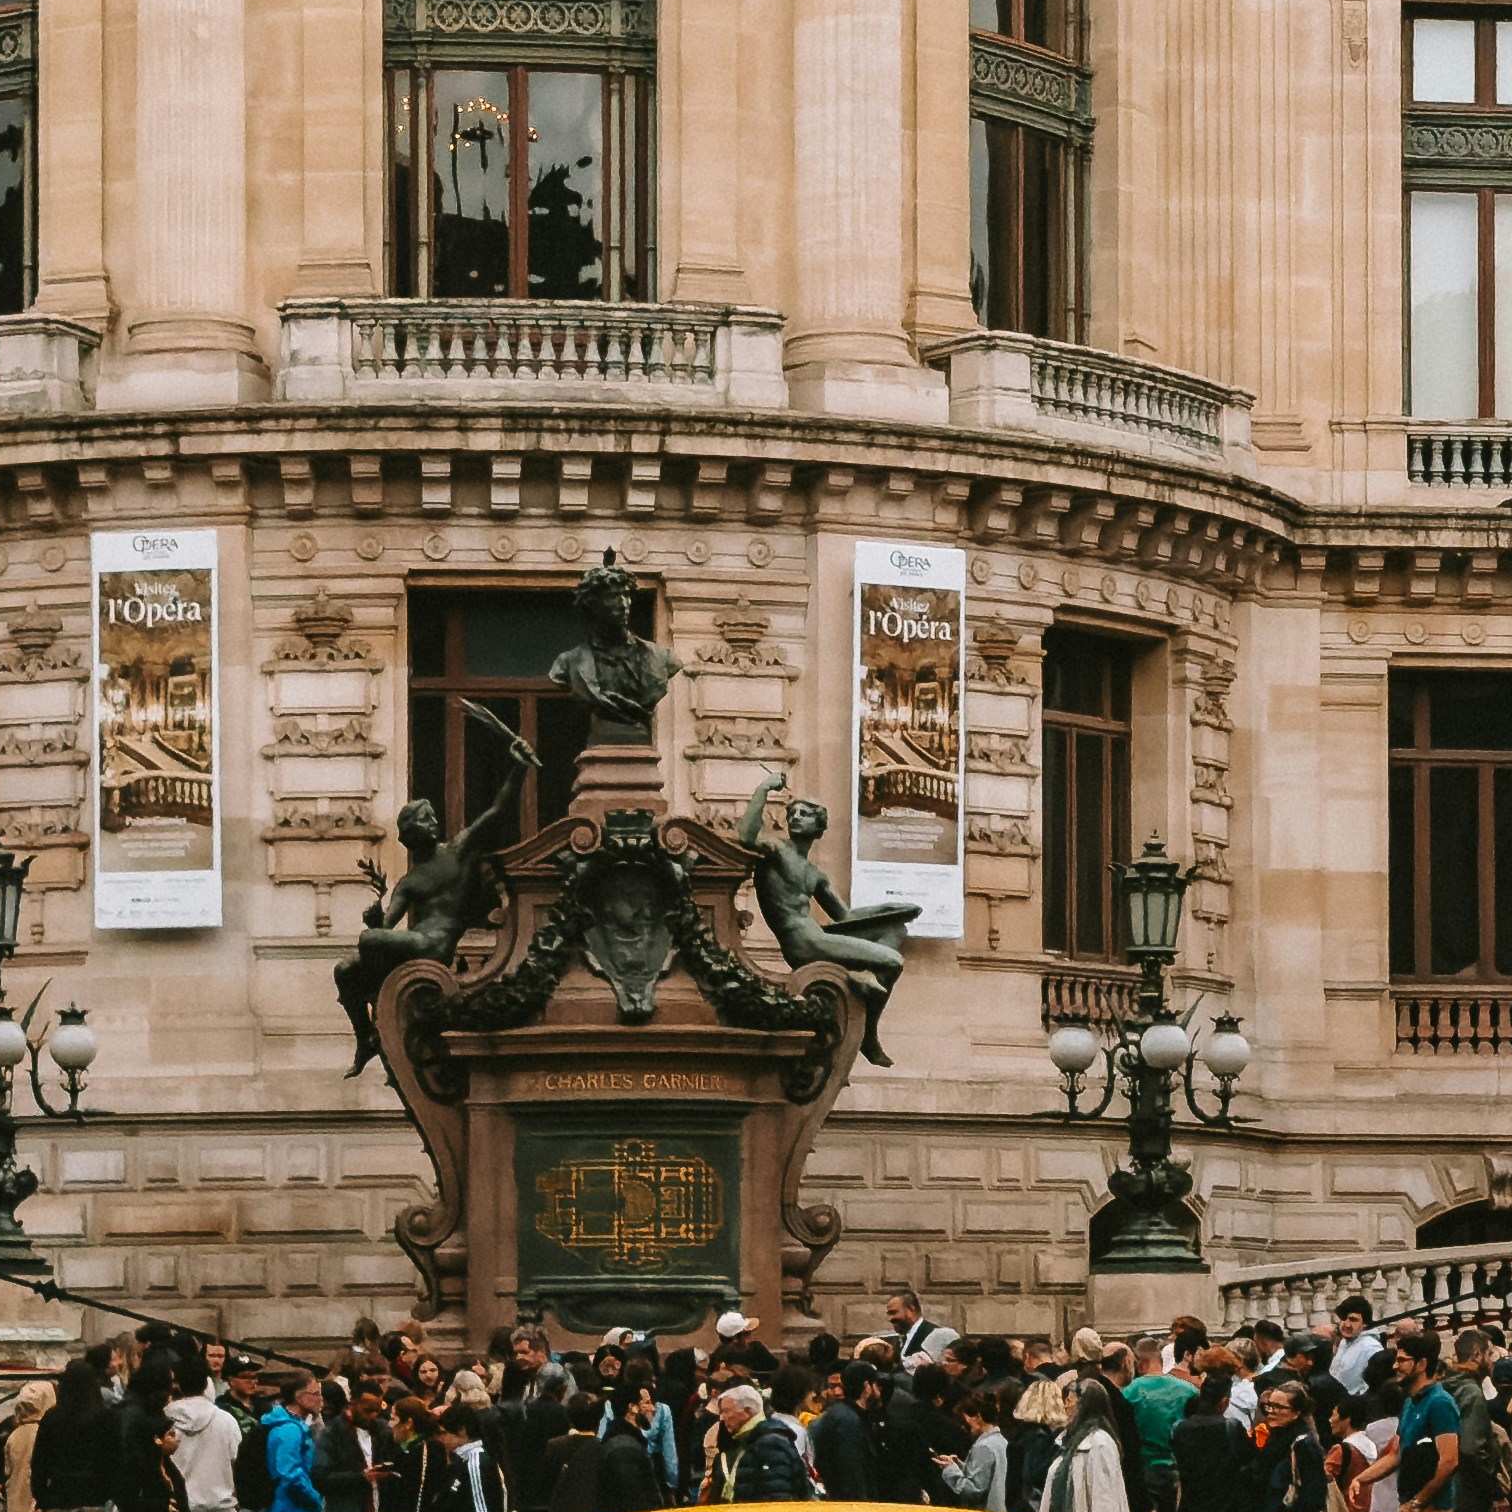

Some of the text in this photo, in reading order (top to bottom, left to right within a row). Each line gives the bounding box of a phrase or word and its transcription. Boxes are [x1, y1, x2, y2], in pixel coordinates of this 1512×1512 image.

[108, 596, 202, 628] l'Opéra
[869, 610, 953, 643] l'Opéra
[545, 1072, 722, 1092] CHARLES GARNIER
